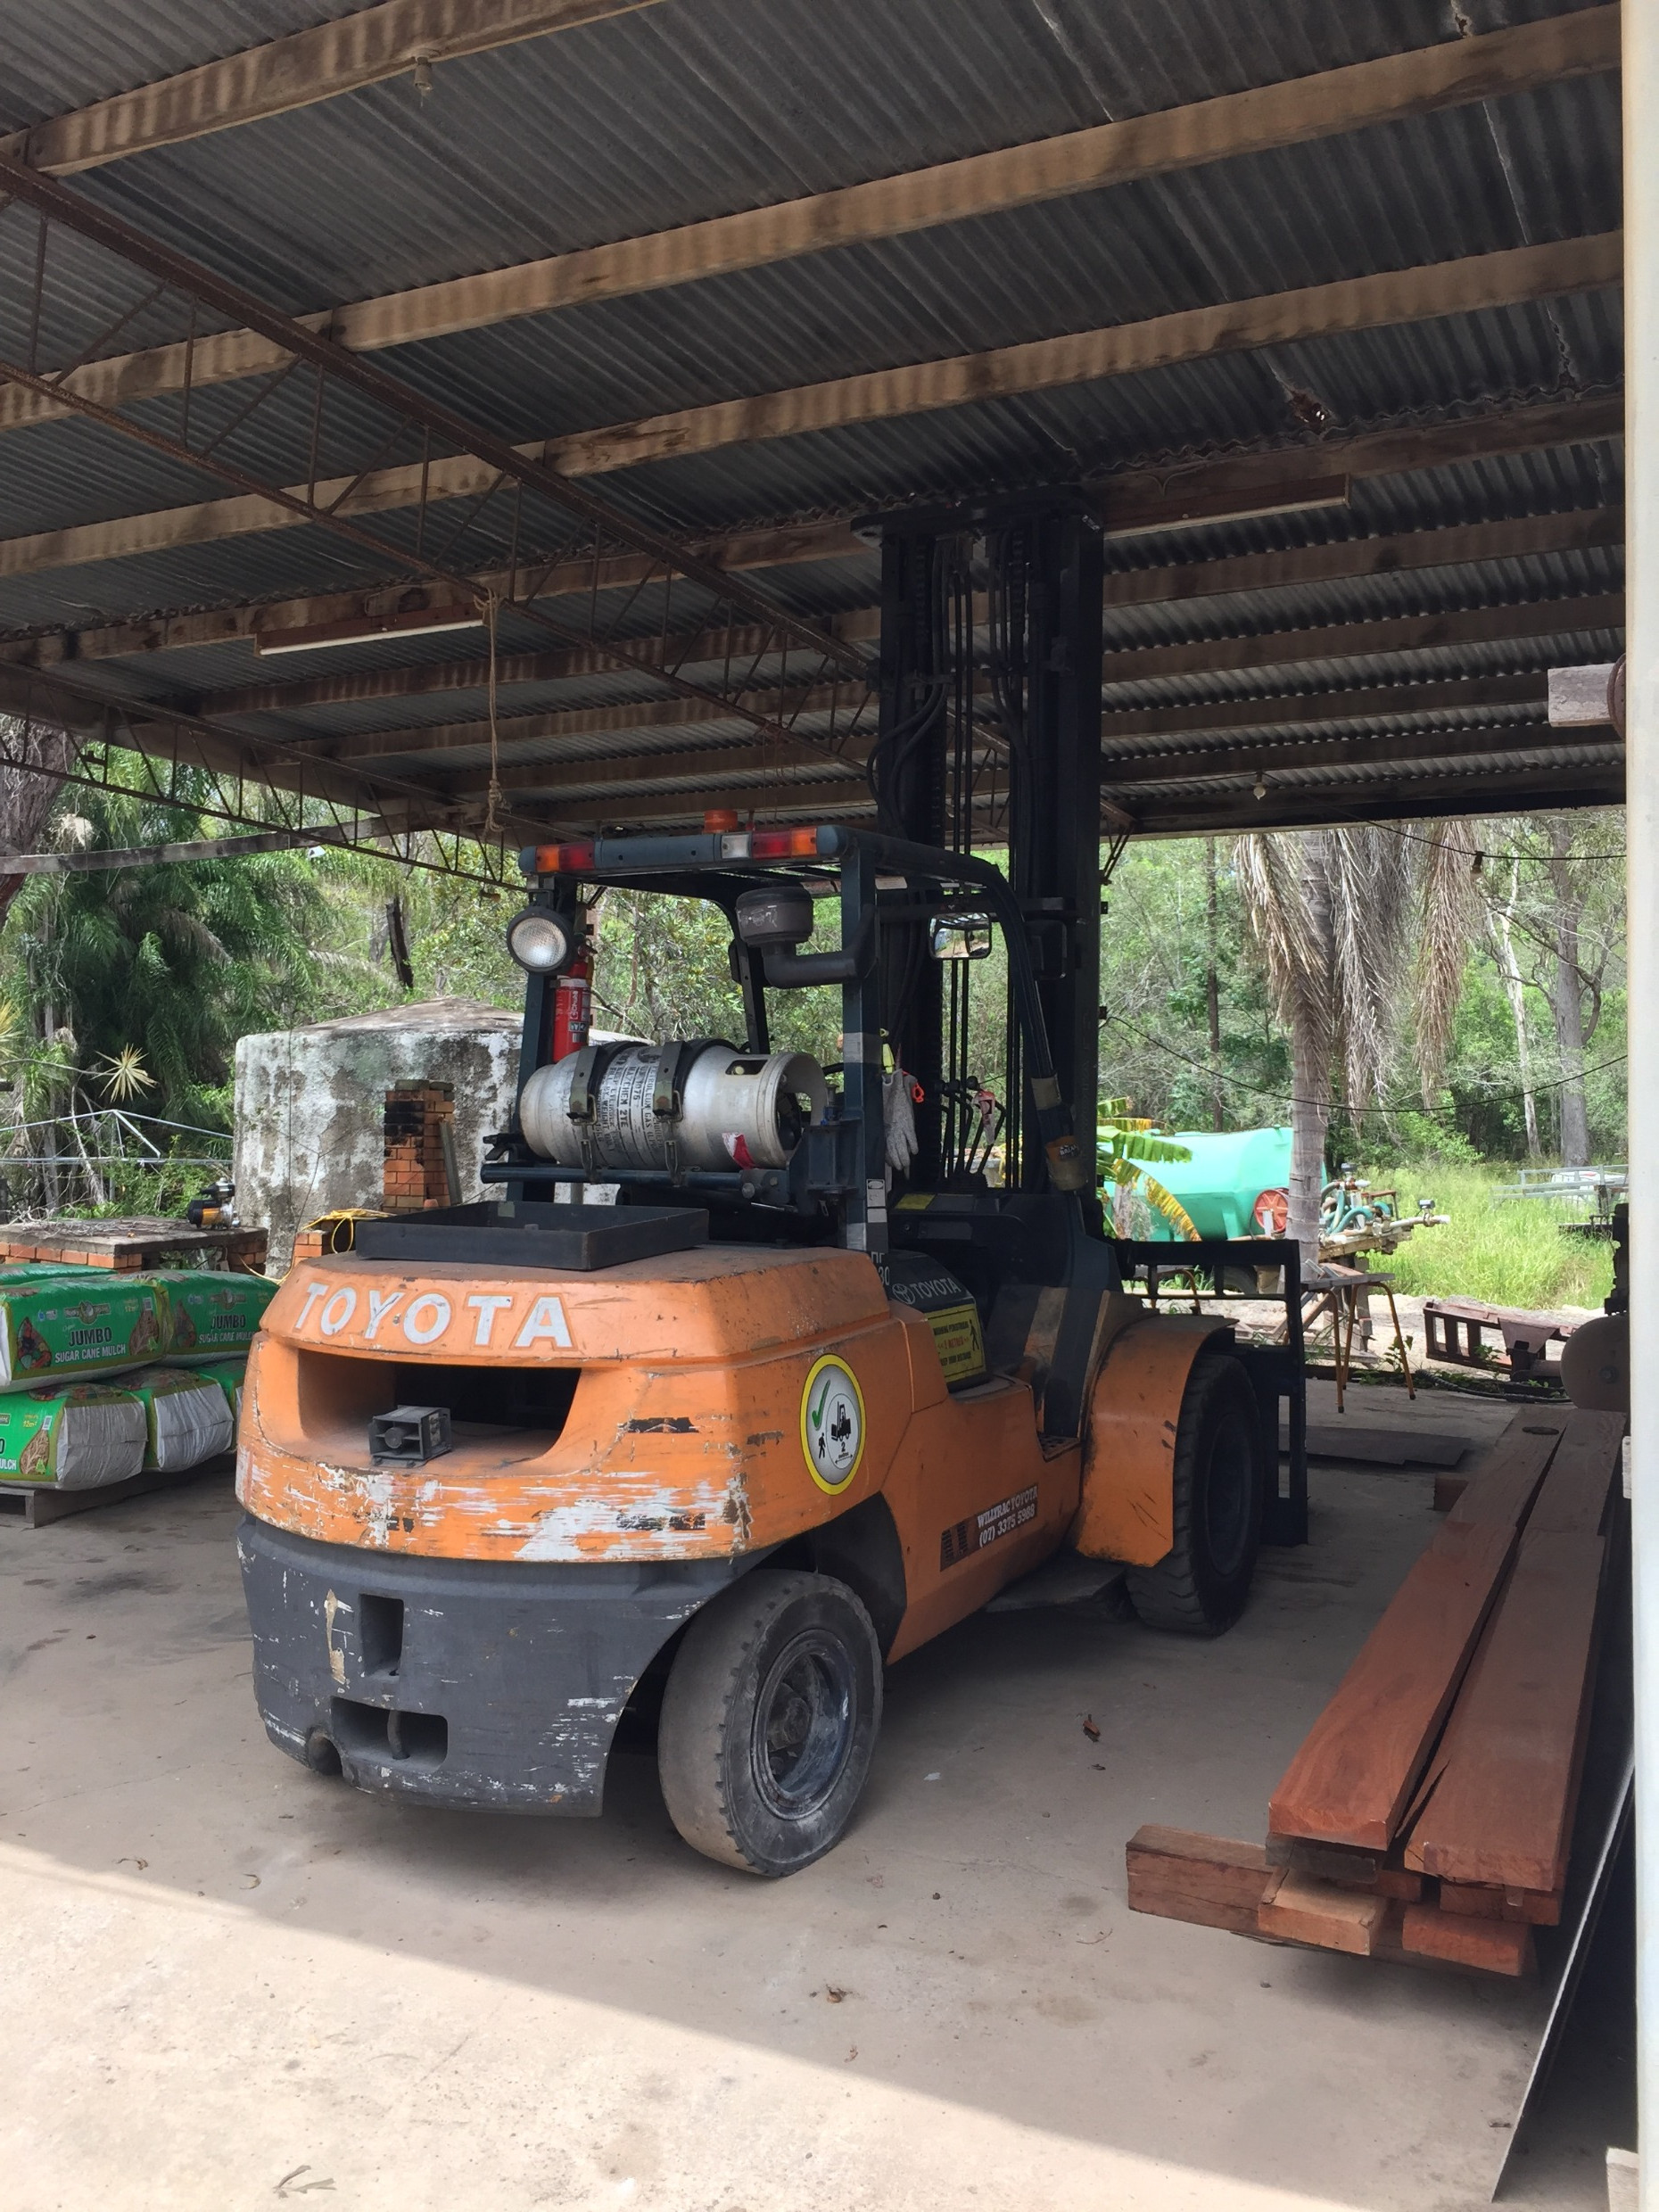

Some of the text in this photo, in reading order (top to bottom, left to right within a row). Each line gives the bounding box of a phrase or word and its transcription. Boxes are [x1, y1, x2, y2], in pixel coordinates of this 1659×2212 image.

[619, 1109, 629, 1128] 2TE
[910, 1277, 961, 1300] TOYOTA
[210, 1314, 246, 1330] JUMBO
[295, 1283, 573, 1348] TOYOTA
[69, 1326, 112, 1348] JUMBO
[199, 1333, 219, 1344] SUGAR
[219, 1332, 235, 1341] CANE
[54, 1343, 126, 1364] SUGAR CANE MULCH
[841, 1441, 846, 1452] 2
[0, 1457, 17, 1471] ULCH
[1011, 1486, 1037, 1510] TOYOTA
[979, 1525, 995, 1548] (07)
[997, 1514, 1016, 1535] 3375
